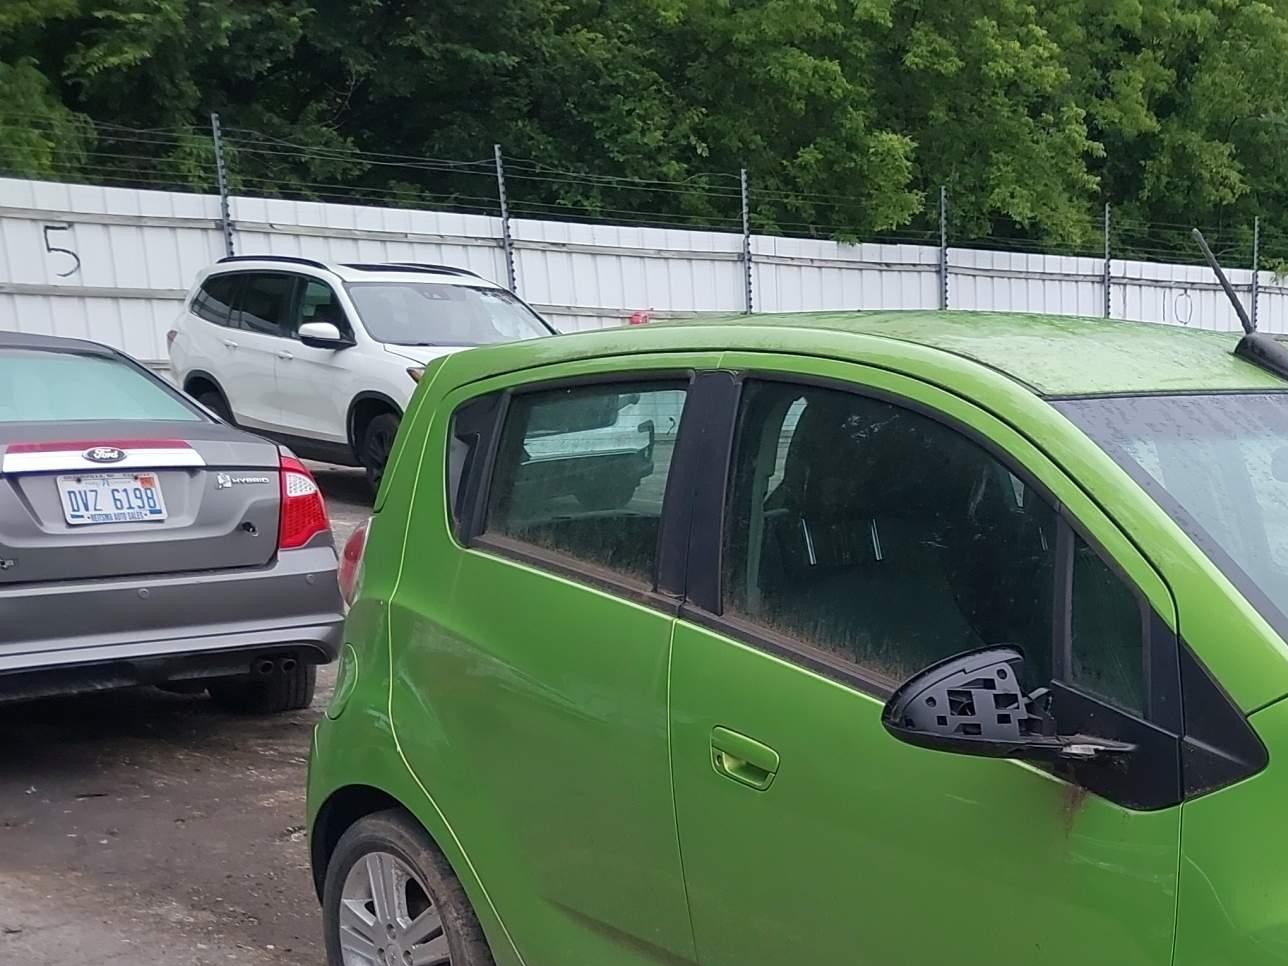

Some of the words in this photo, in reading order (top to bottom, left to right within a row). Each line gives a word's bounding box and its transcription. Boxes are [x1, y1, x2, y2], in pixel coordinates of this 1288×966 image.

[44, 223, 80, 277] 5
[92, 447, 119, 459] Ford
[67, 490, 103, 513] DVZ
[111, 488, 157, 511] 6198
